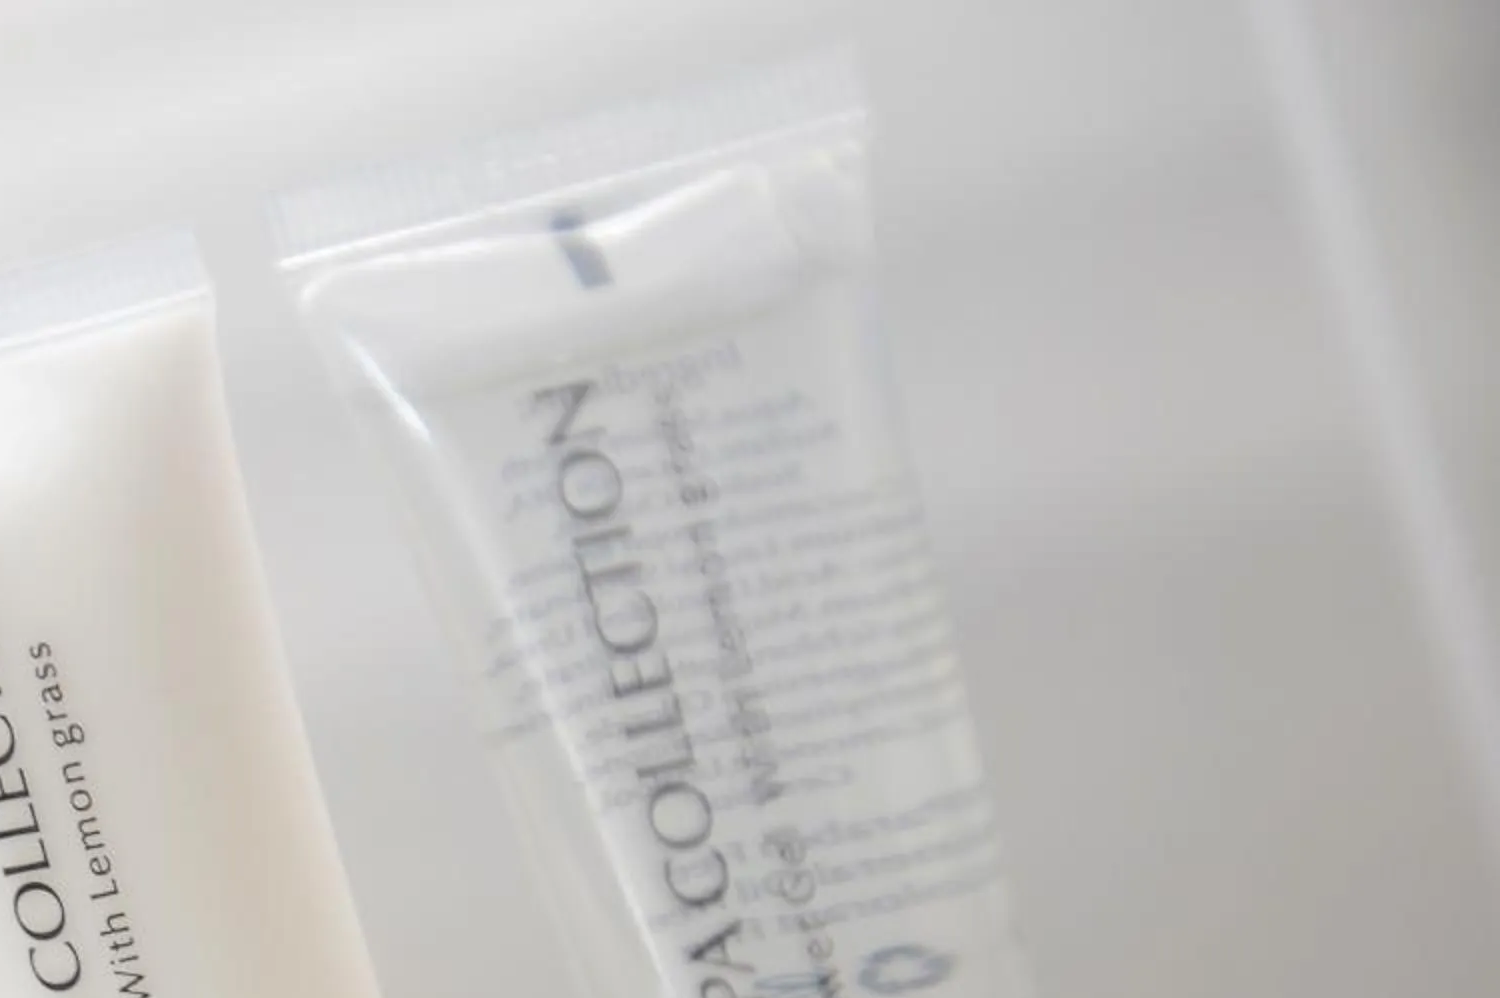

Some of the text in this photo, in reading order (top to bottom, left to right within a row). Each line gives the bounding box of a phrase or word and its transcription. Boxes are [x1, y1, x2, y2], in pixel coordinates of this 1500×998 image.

[29, 641, 86, 748] grass
[534, 380, 730, 908] COLLECTION
[61, 759, 118, 901] Lemon
